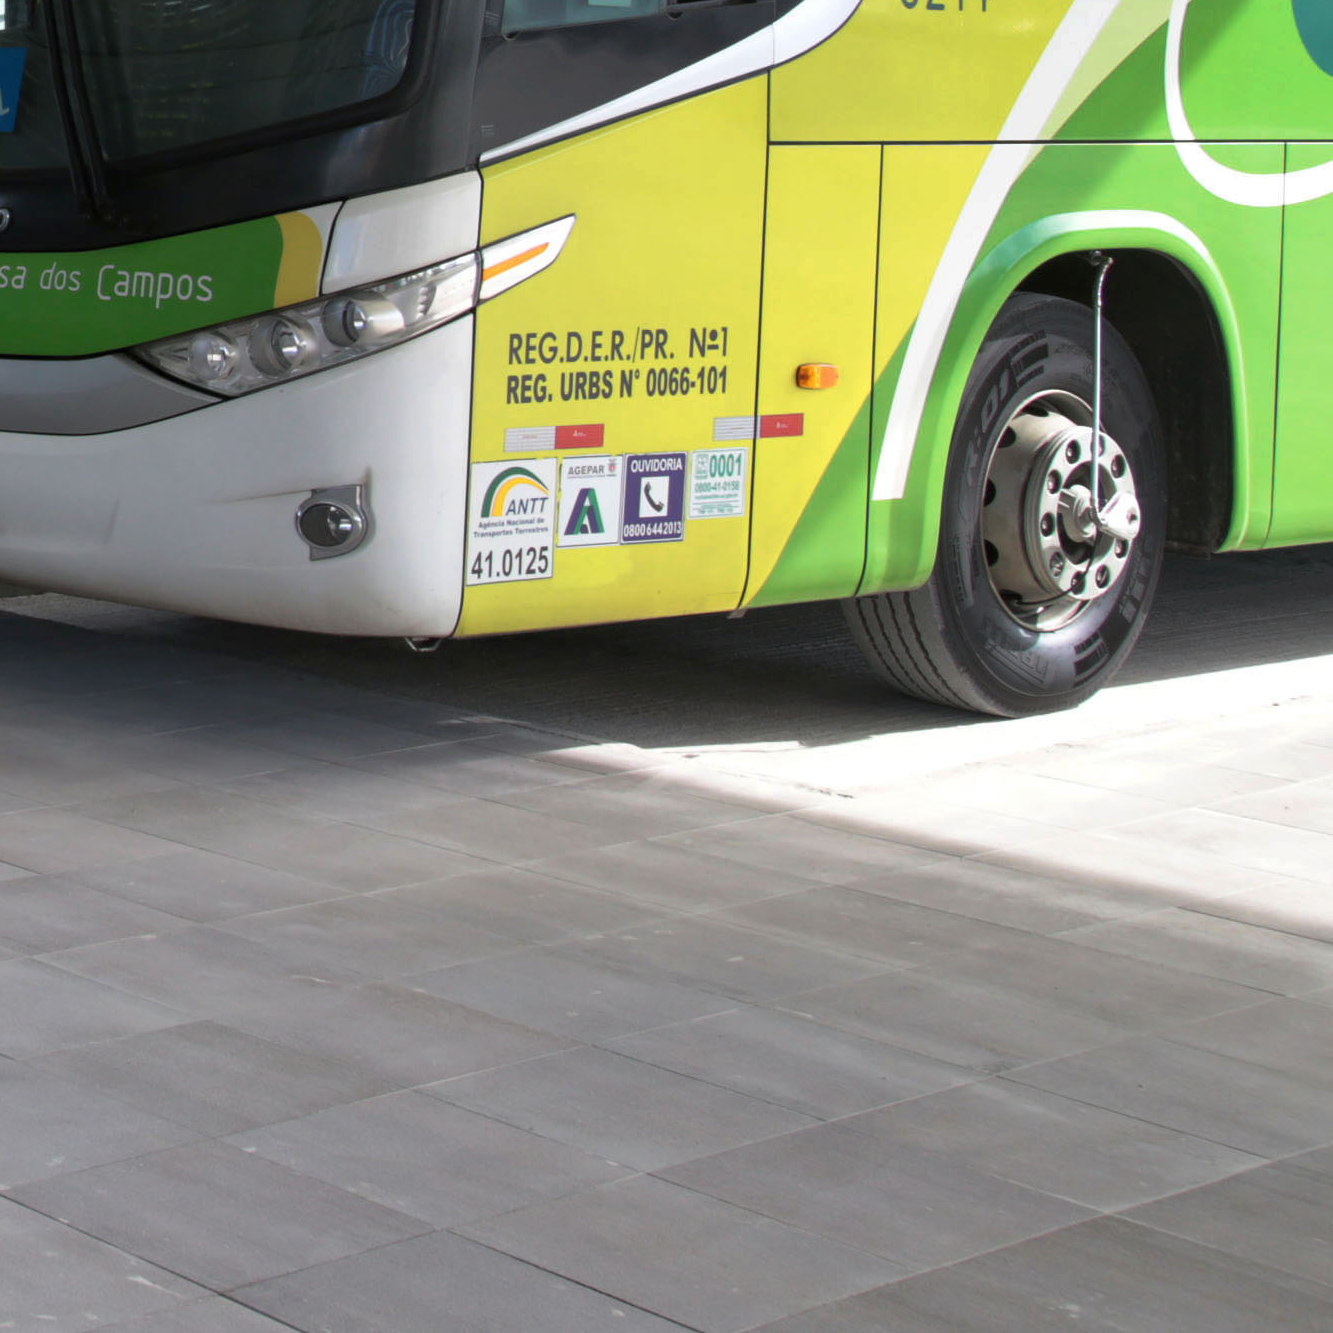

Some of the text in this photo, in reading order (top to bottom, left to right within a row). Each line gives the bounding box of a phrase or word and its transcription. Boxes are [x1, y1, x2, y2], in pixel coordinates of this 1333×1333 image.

[40, 262, 81, 291] dos
[97, 265, 213, 309] Campos
[506, 373, 553, 404] REG.
[560, 370, 613, 401] URBS
[646, 365, 727, 397] 0066-101
[568, 465, 605, 475] AGEPAR
[631, 457, 683, 473] OUVIDORIA
[709, 453, 742, 478] 0001
[506, 497, 549, 516] ANTT
[471, 546, 548, 579] 41.0125
